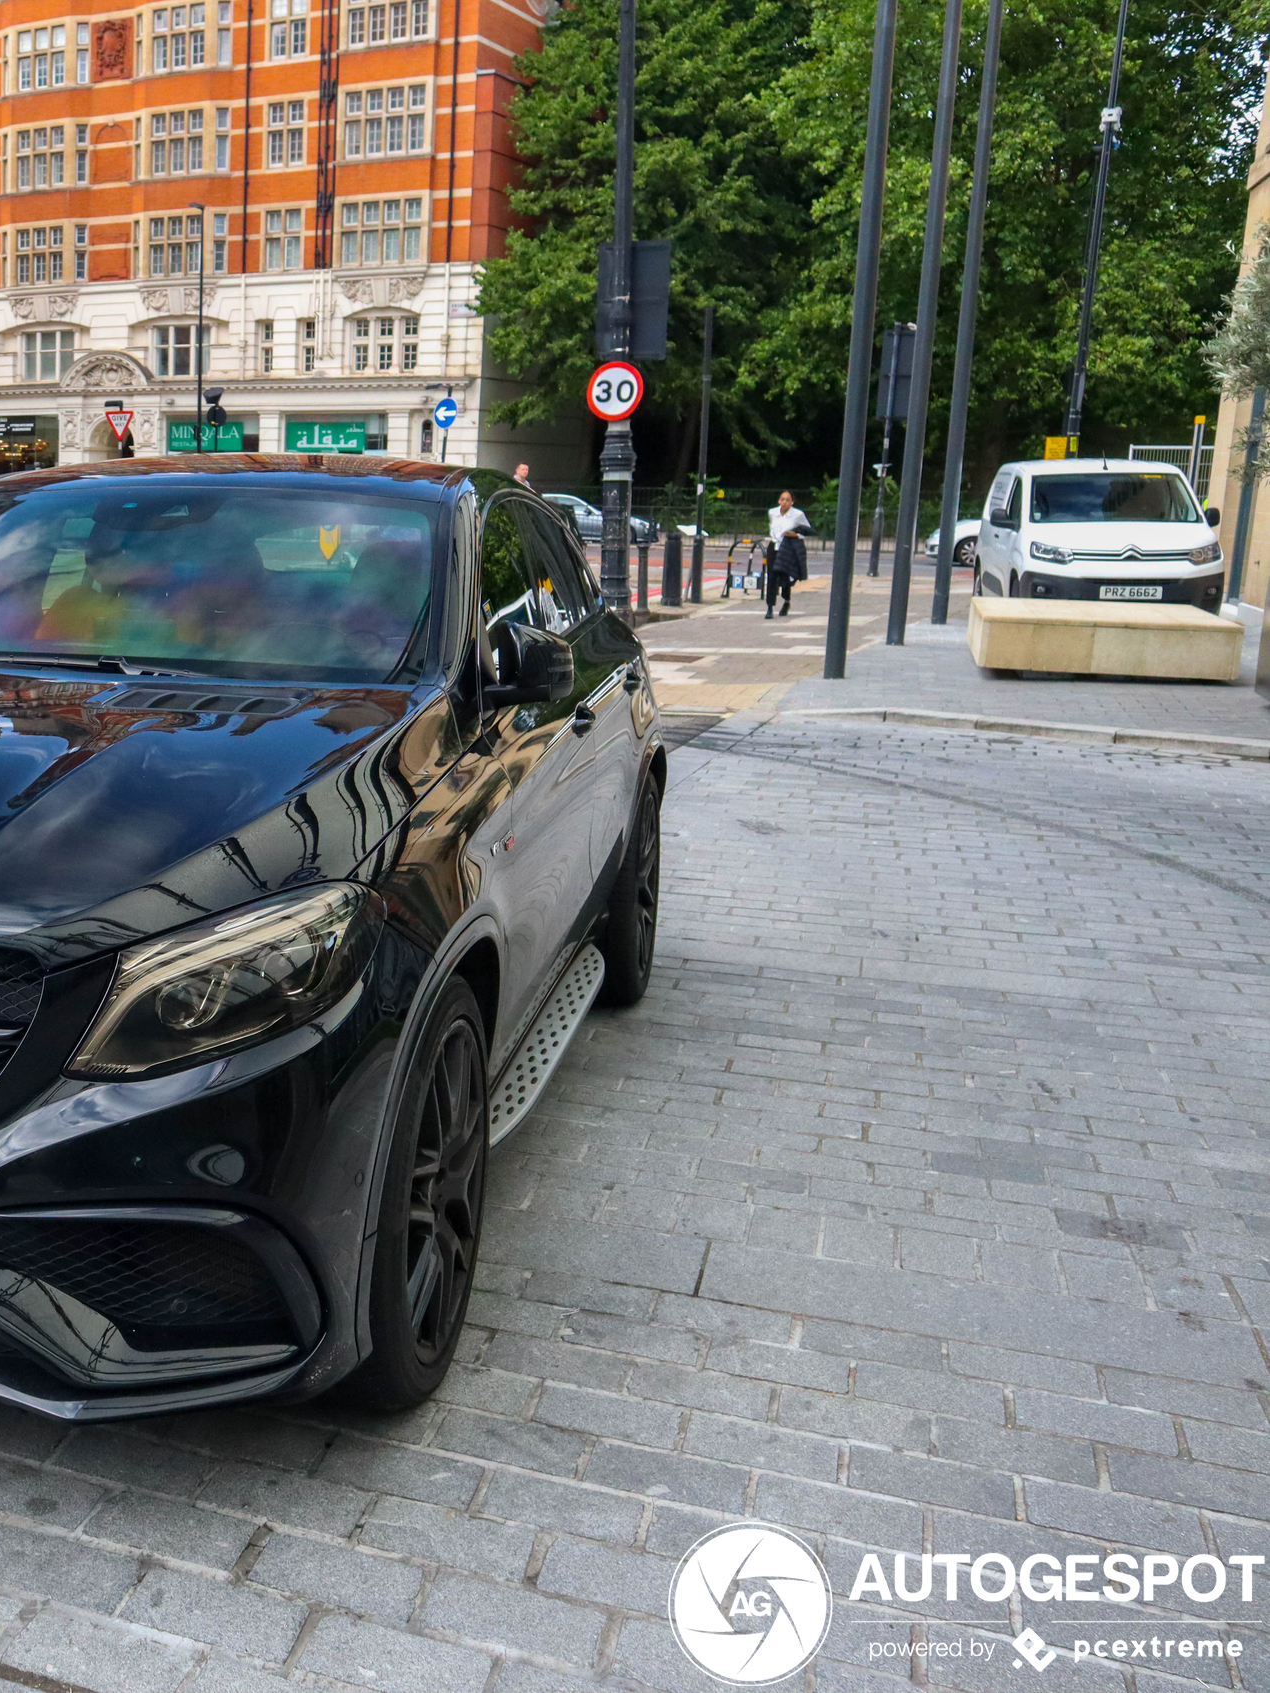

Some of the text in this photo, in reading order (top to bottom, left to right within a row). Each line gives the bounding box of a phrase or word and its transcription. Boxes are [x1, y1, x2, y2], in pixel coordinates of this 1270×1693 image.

[595, 379, 635, 403] 30
[296, 424, 358, 448] منقلة
[1104, 587, 1158, 598] PRZ 6662
